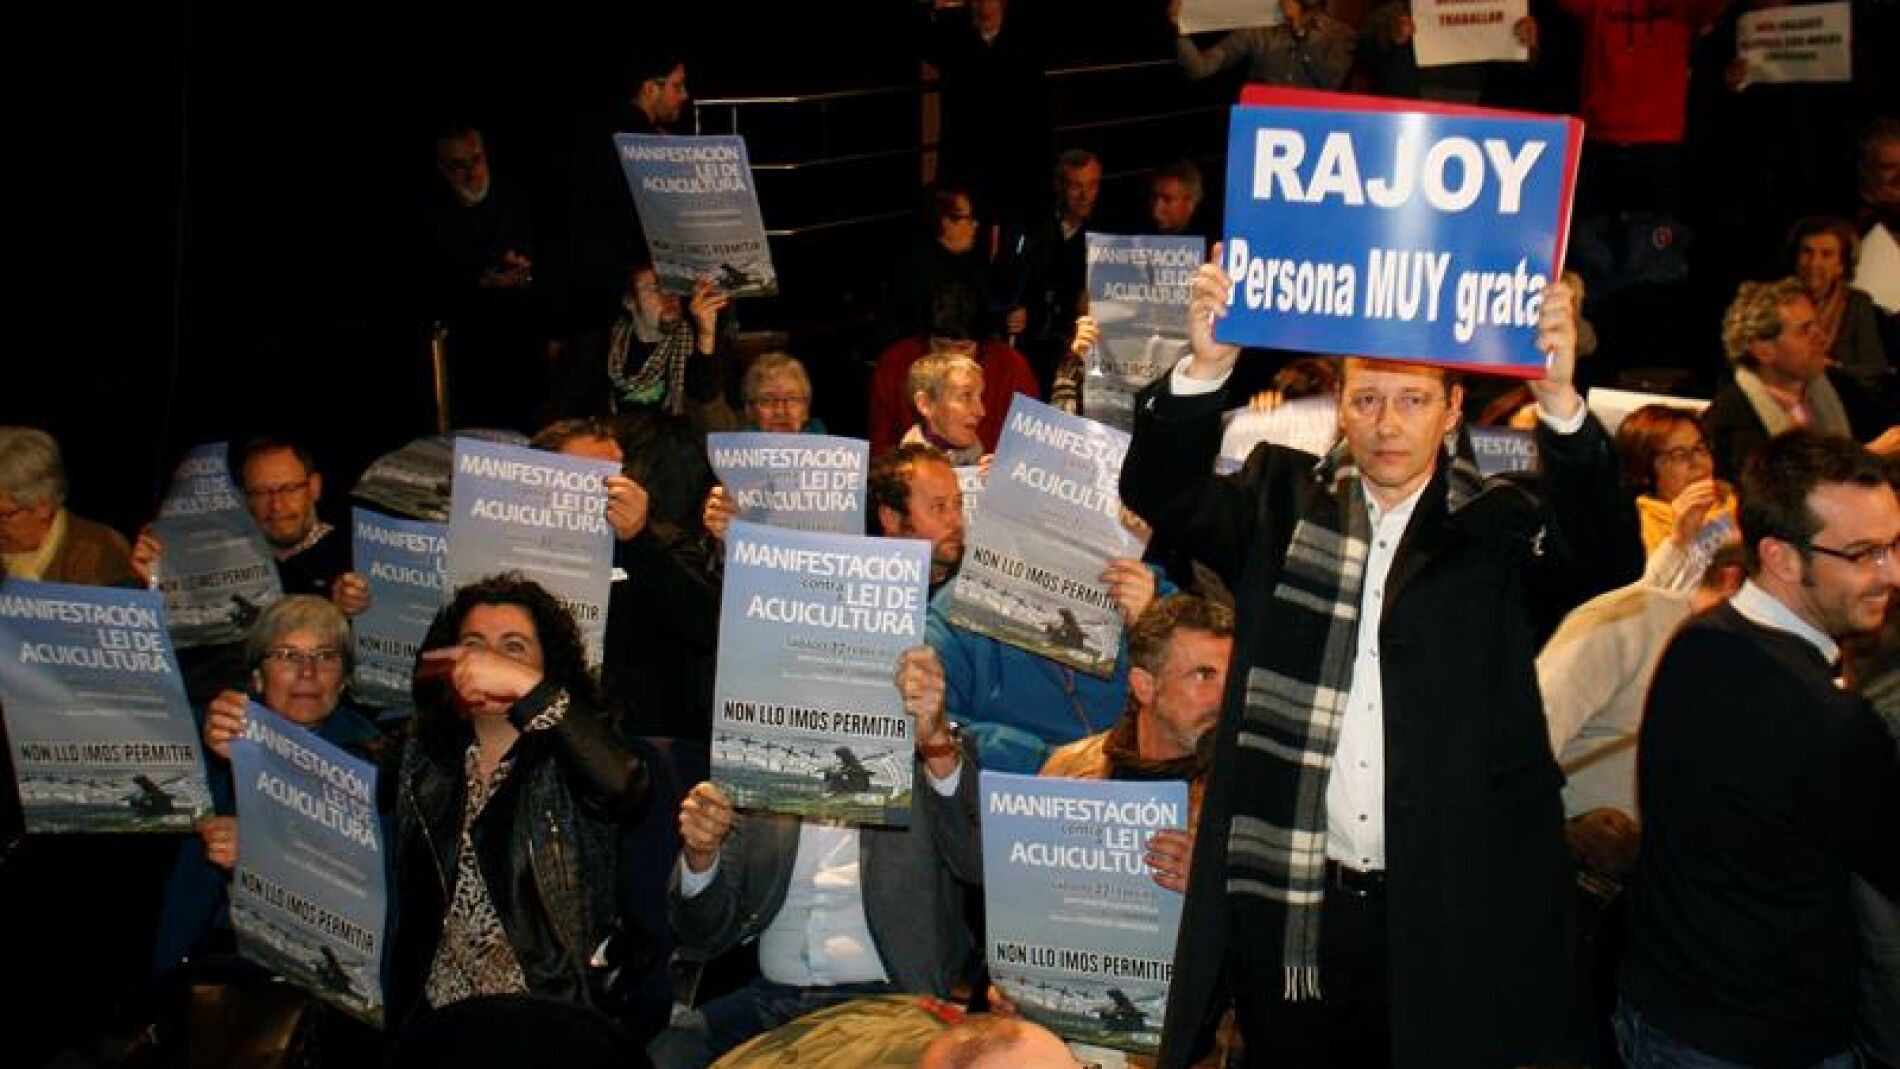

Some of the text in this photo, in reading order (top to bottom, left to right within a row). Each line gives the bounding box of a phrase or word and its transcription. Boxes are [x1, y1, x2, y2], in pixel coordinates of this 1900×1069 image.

[1253, 127, 1547, 214] RAJOY
[1225, 238, 1547, 342] Persona MUY grata
[714, 446, 861, 470] MANIFESTACIÓN
[802, 470, 829, 490] LEI
[833, 471, 860, 491] DE
[471, 498, 608, 536] ACUICULTURA
[553, 490, 581, 512] LEI
[738, 488, 858, 512] ACUICULTURA
[357, 521, 449, 555] MANIFESTA
[734, 540, 923, 583] MANIFESTACIÓN
[0, 594, 160, 629] MANIFESTACIÓN
[747, 595, 915, 635] ACUICULTURA
[847, 583, 919, 612] LEI DE
[723, 699, 906, 739] NON LLO IMOS PERMITIR
[988, 792, 1177, 827] MANIFESTACIÓN
[1105, 826, 1139, 850] LEI
[1009, 841, 1155, 876] ACUICULTU
[996, 942, 1027, 963] NON
[1032, 947, 1056, 968] LLO
[1060, 948, 1098, 973] IMOS
